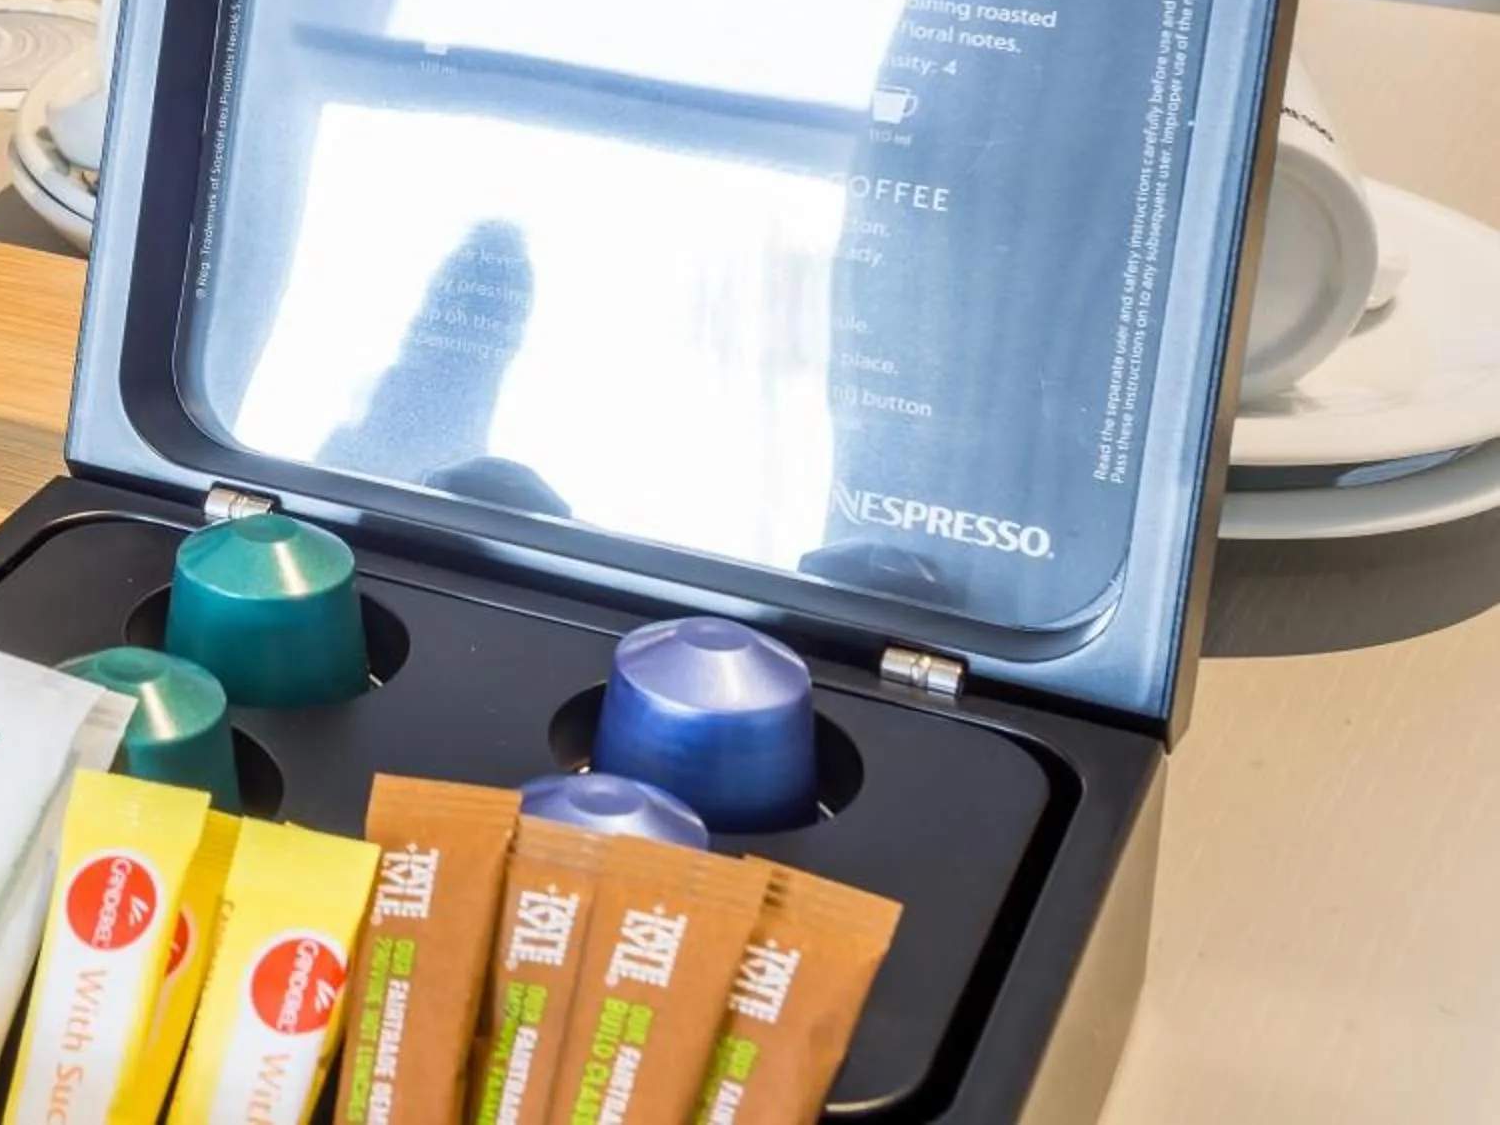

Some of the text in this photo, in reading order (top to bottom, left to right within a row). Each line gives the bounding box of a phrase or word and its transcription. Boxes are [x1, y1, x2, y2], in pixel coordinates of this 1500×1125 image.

[977, 4, 1056, 29] roasted
[1160, 0, 1176, 28] and
[1178, 7, 1193, 32] the
[959, 29, 1022, 54] notes.
[1158, 29, 1172, 55] use
[1176, 33, 1189, 50] of
[943, 58, 958, 76] 4
[1149, 56, 1168, 102] before
[1174, 51, 1187, 76] use
[1162, 78, 1185, 145] Improper
[1140, 105, 1163, 165] carefully
[1158, 146, 1173, 180] user.
[849, 176, 950, 212] OFFEE
[1128, 167, 1151, 248] instructions
[1144, 181, 1170, 262] subsequent
[1122, 250, 1141, 293] safety
[1142, 264, 1157, 290] any
[1117, 295, 1133, 322] and
[1137, 290, 1151, 307] to
[1136, 309, 1148, 328] on
[1115, 324, 1129, 354] user
[1121, 330, 1145, 410] instructions
[1104, 356, 1126, 416] separate
[861, 389, 932, 417] button
[1100, 417, 1115, 442] the
[1115, 412, 1133, 450] these
[1094, 444, 1111, 480] Read
[1110, 452, 1126, 484] Pass
[400, 849, 440, 920] TATE
[61, 969, 107, 1052] With
